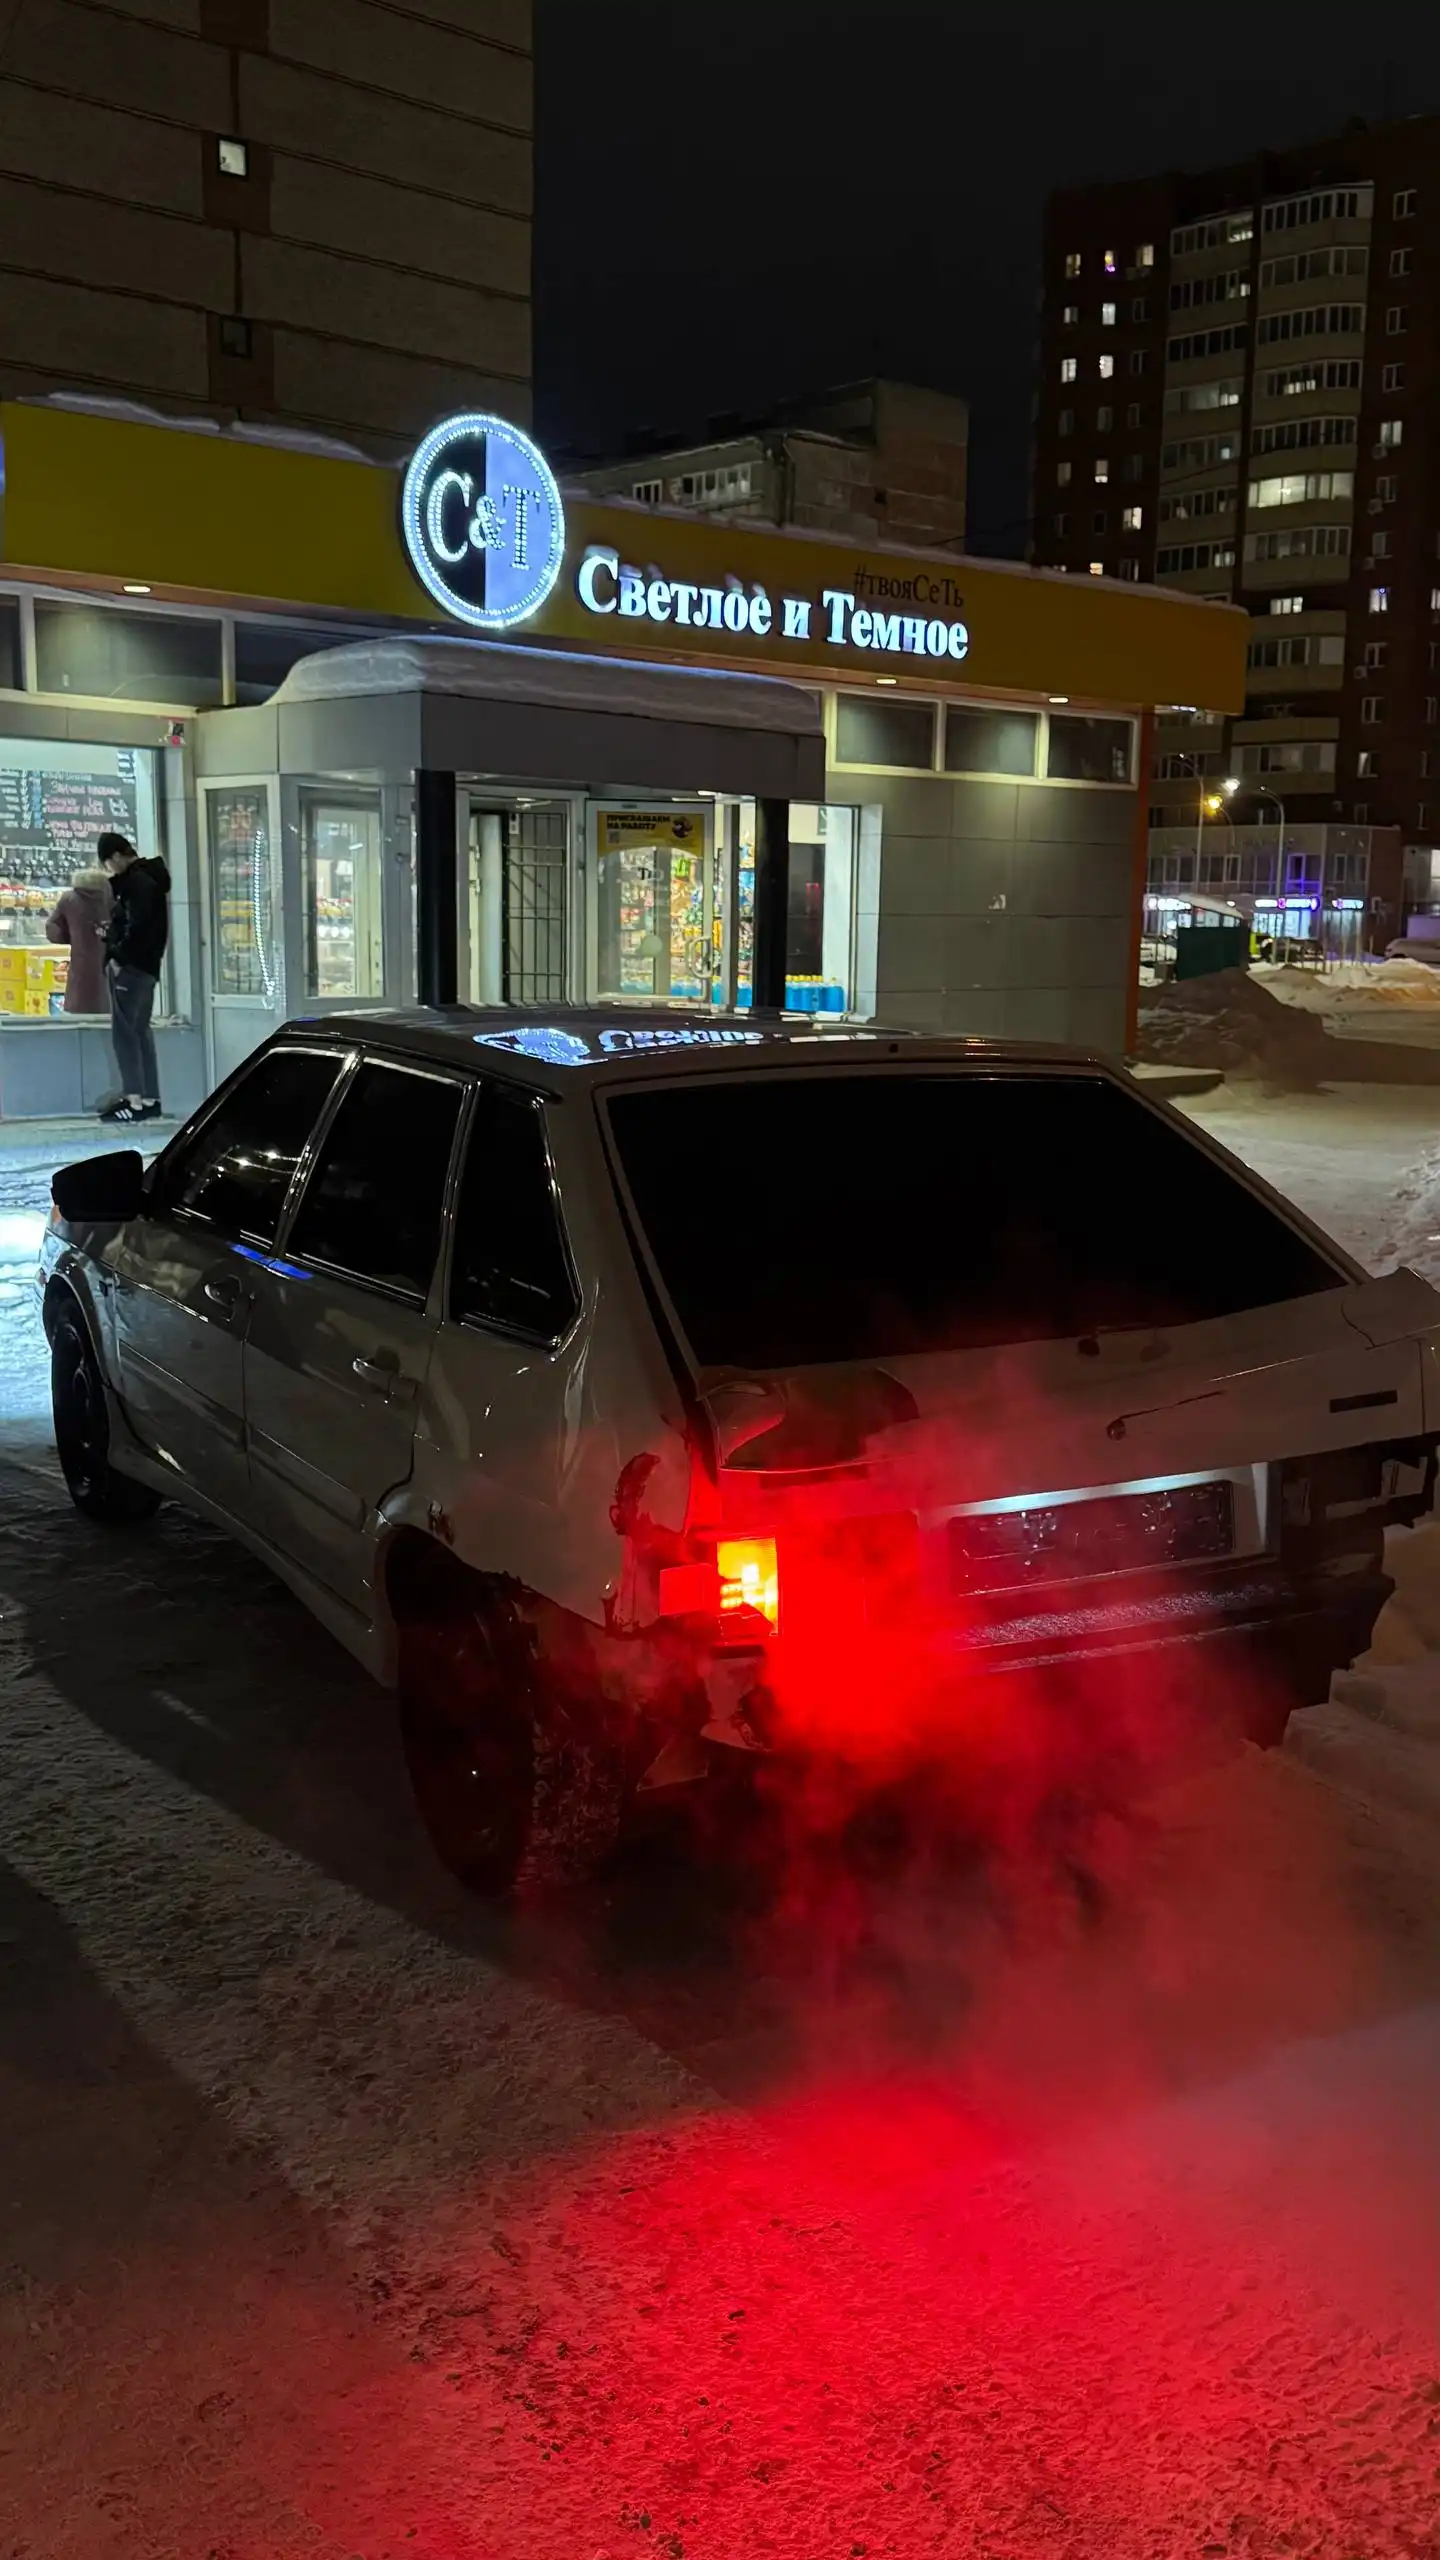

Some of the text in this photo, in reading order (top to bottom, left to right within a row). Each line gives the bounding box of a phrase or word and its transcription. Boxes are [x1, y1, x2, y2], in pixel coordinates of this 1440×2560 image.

[577, 553, 969, 660] Светлое и Темное
